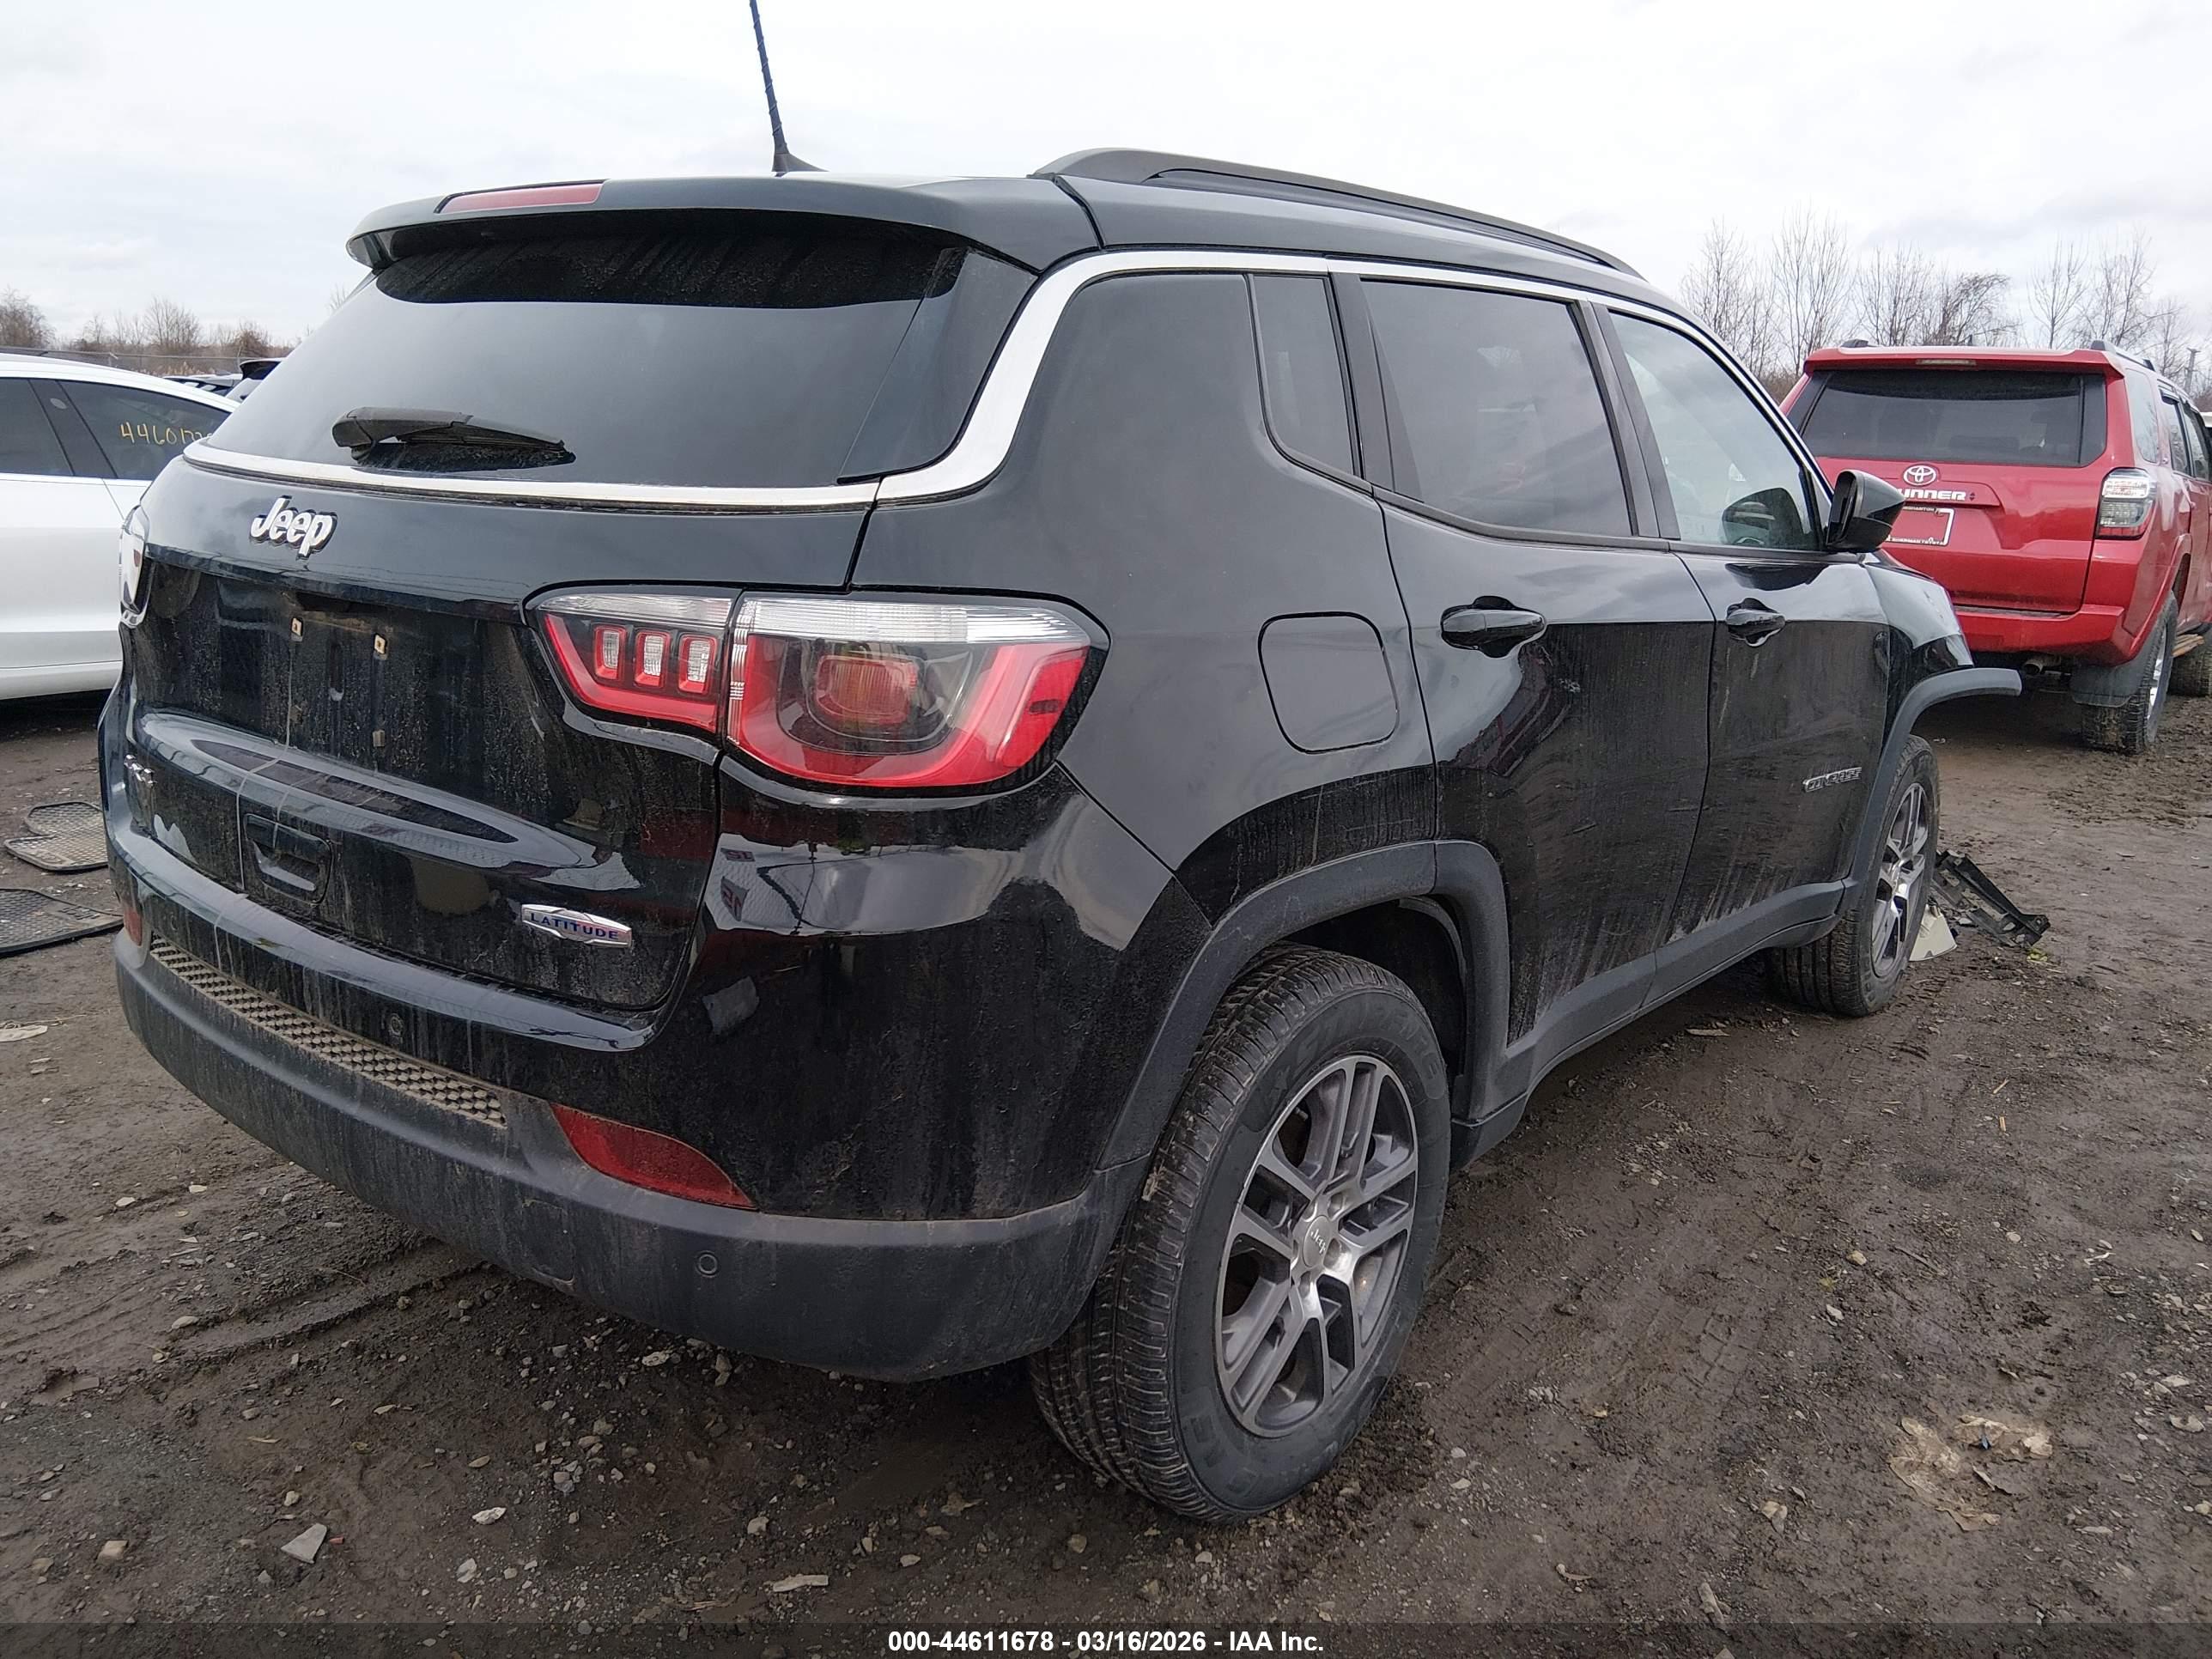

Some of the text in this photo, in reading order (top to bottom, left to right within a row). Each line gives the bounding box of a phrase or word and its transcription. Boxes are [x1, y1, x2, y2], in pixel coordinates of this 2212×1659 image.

[120, 422, 213, 445] 446017
[250, 495, 337, 560] Jeep
[530, 912, 619, 940] LATITUDE
